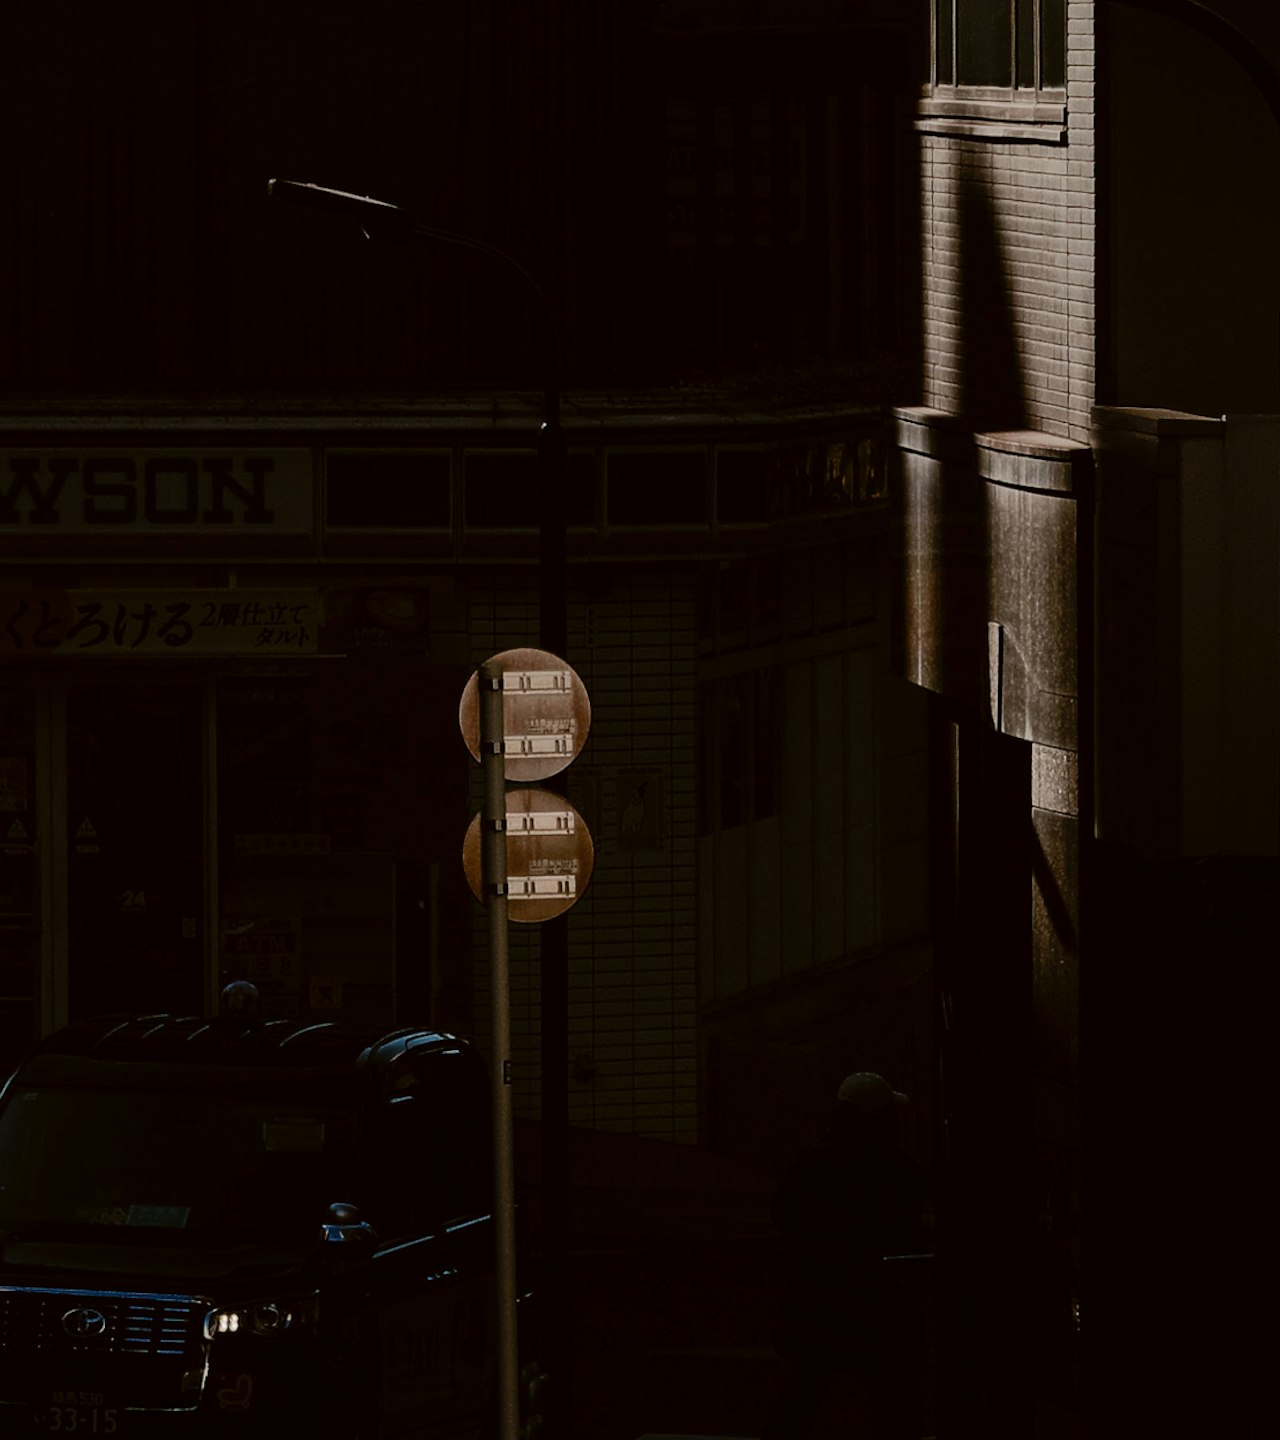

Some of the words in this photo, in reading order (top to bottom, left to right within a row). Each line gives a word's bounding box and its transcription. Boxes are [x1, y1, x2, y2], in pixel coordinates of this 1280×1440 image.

[0, 458, 274, 525] WSON
[254, 626, 311, 647] タルト
[122, 890, 147, 907] 24
[236, 935, 286, 951] ATM
[49, 1406, 118, 1433] 33-15
